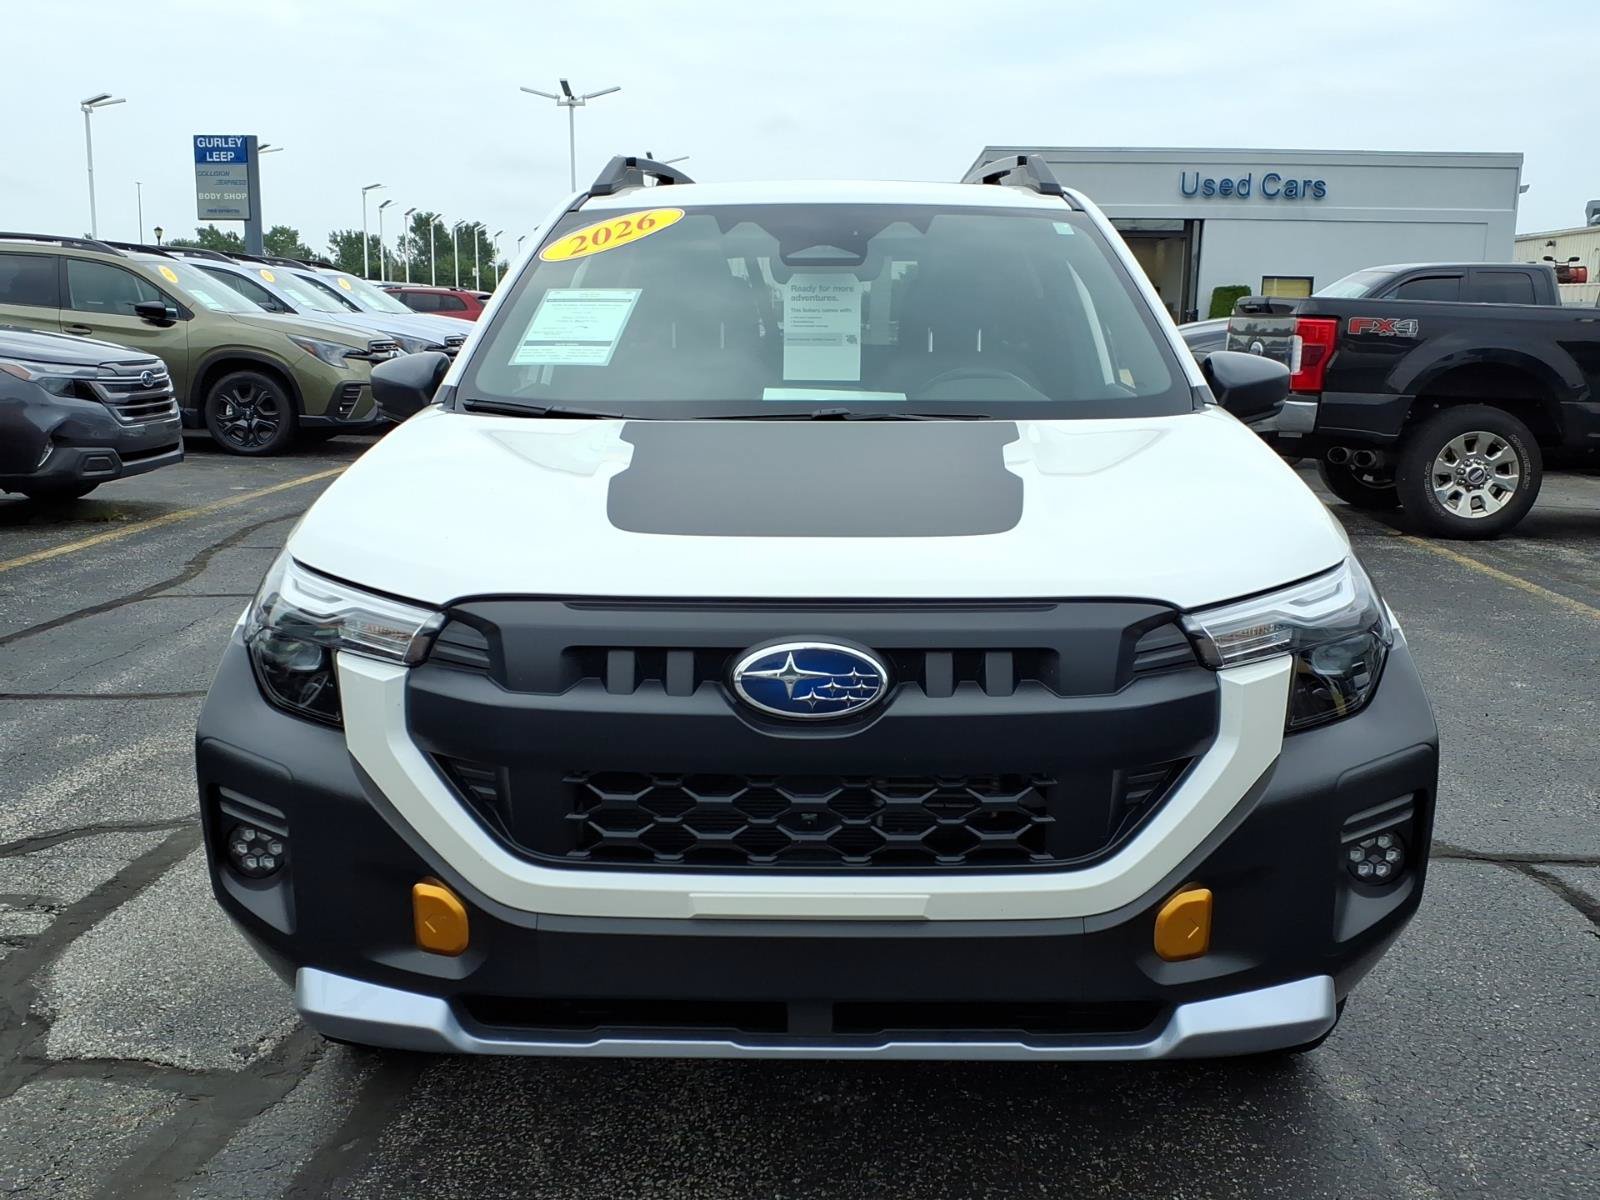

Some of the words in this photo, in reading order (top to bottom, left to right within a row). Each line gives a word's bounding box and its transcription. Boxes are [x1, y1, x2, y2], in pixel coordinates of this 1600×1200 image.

[197, 138, 243, 148] GURLEY
[206, 151, 235, 162] LEEP
[1181, 171, 1252, 198] Used
[1261, 172, 1327, 198] Cars
[569, 212, 656, 255] 2026
[790, 284, 816, 294] Ready
[818, 284, 831, 293] for
[1347, 316, 1419, 335] FX4
